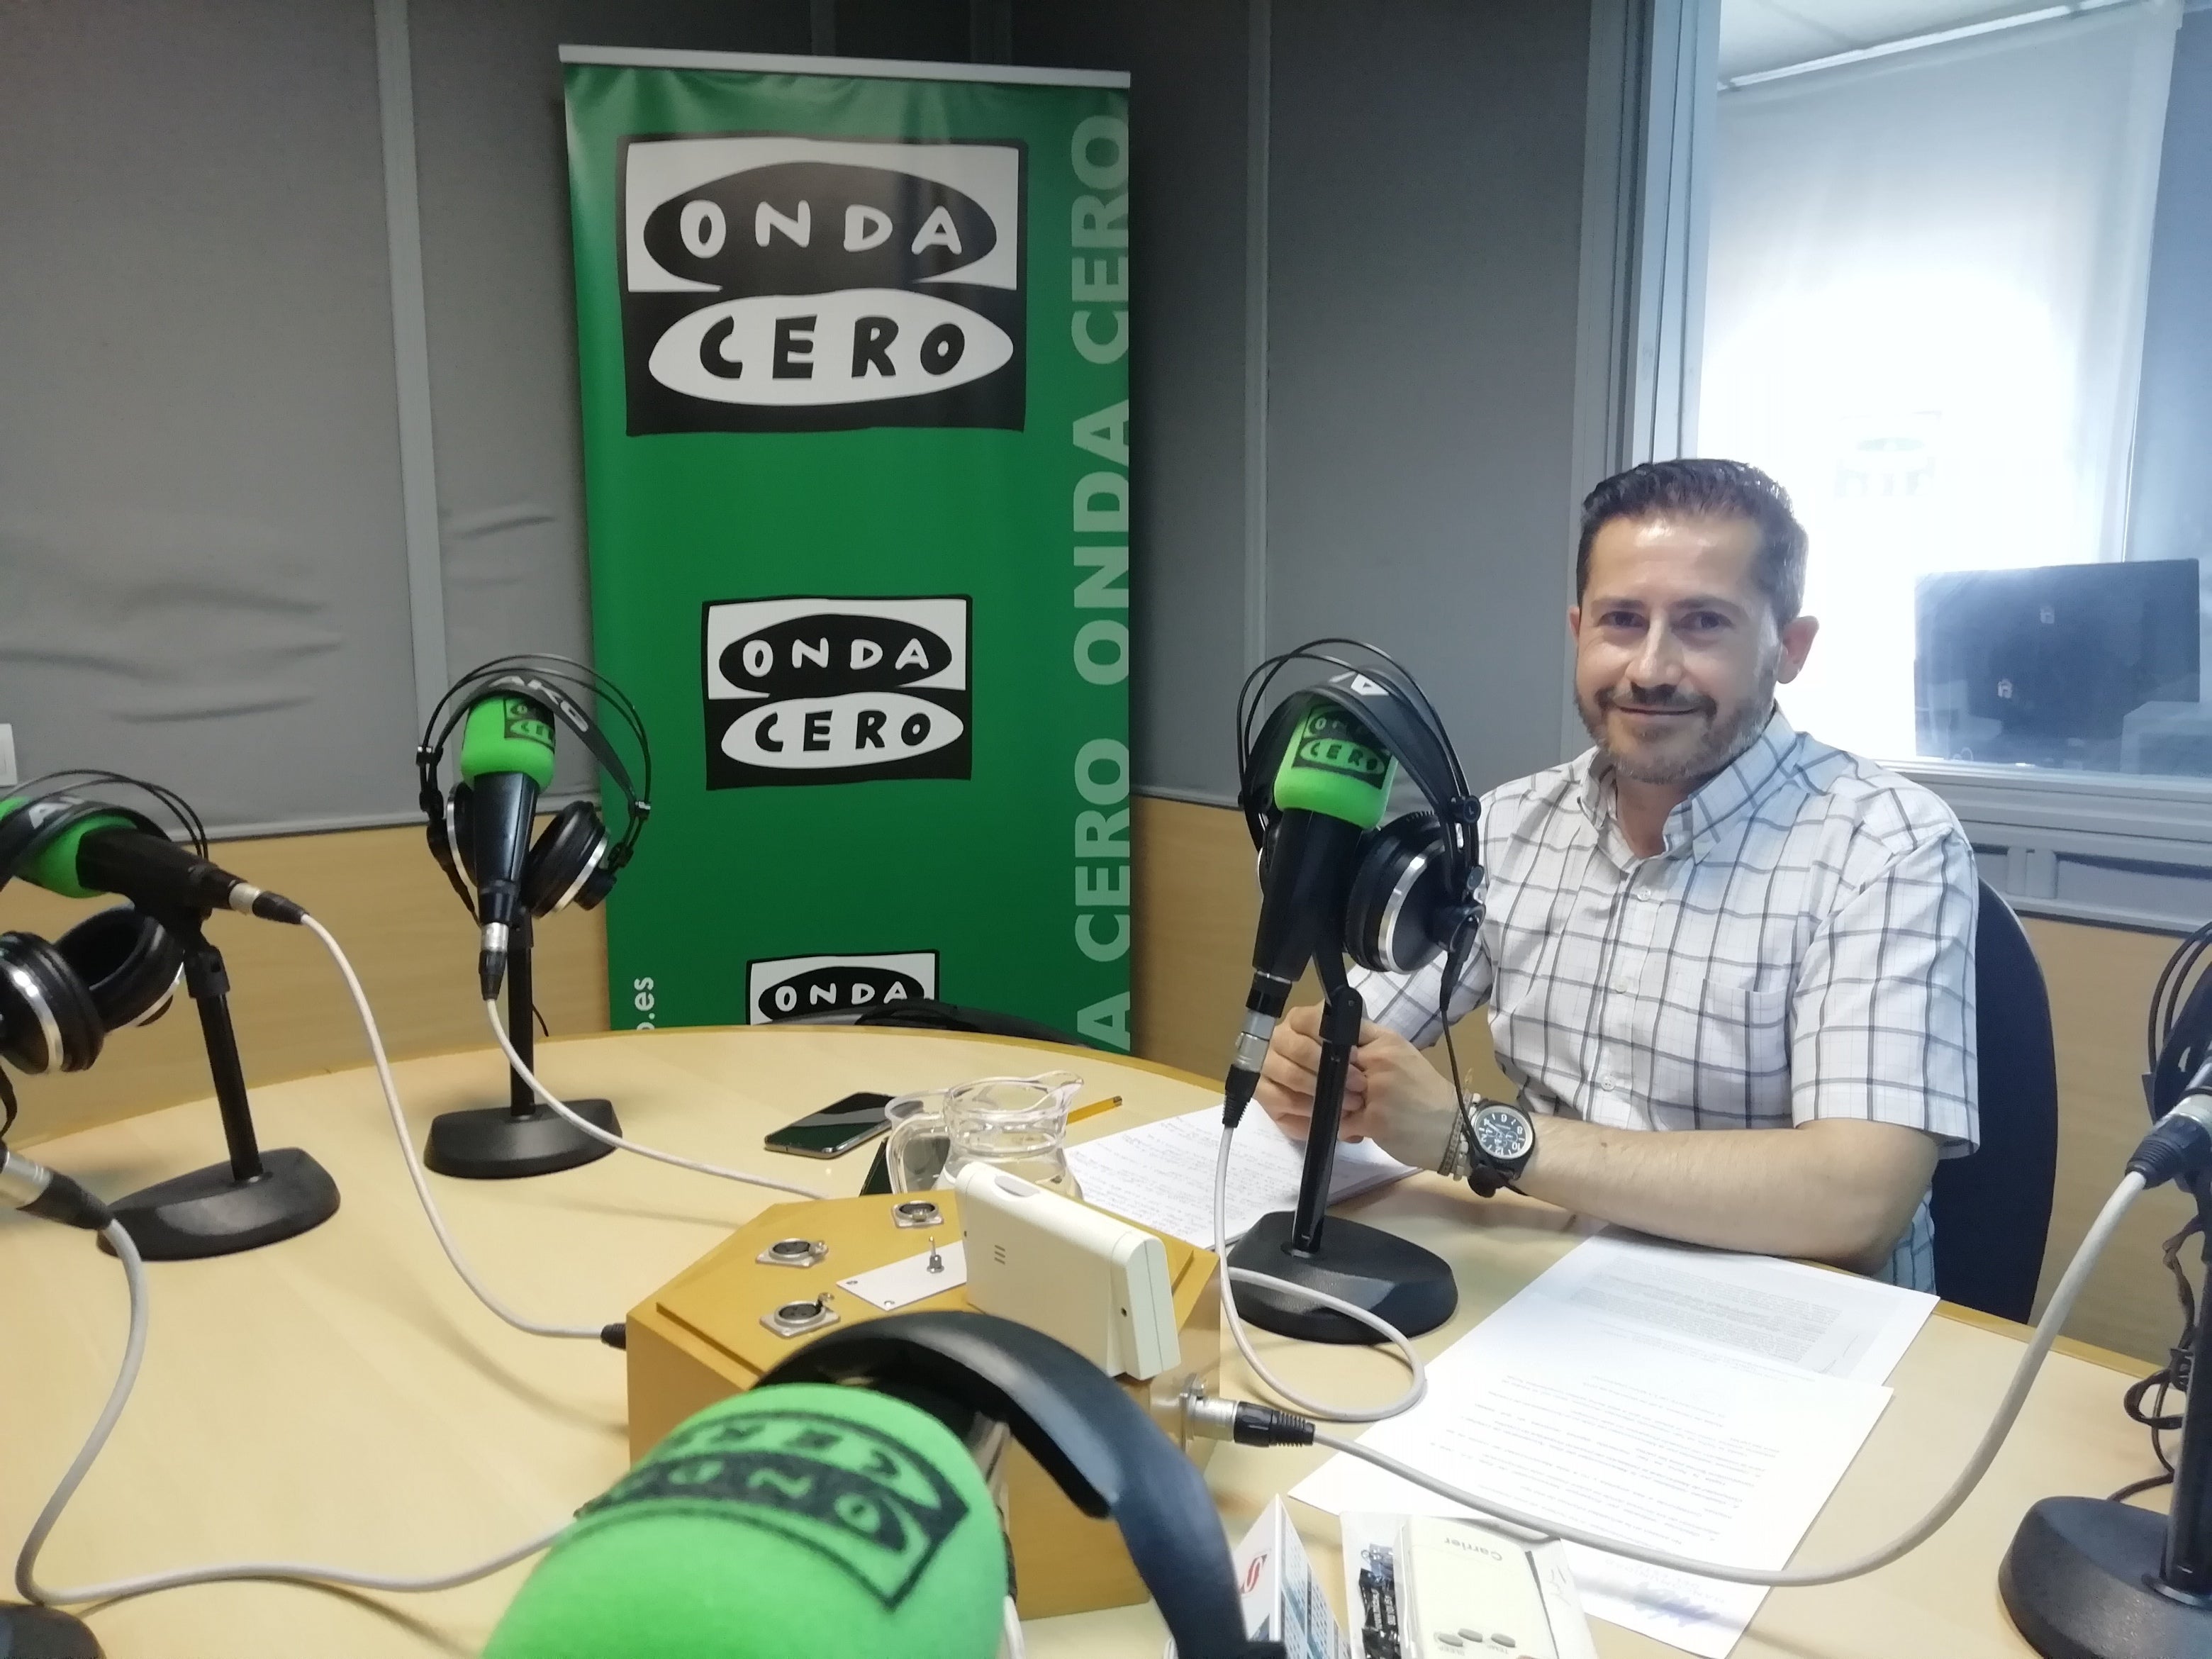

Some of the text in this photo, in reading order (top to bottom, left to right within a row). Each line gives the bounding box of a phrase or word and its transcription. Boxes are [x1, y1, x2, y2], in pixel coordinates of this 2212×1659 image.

[679, 199, 963, 258] ONDA
[1071, 115, 1129, 364] CERO
[699, 314, 966, 380] CERO
[1072, 398, 1129, 686] ONDA
[742, 637, 929, 676] ONDA
[754, 709, 932, 752] CERO
[1074, 738, 1130, 962] CERO
[774, 981, 908, 1012] ONDA
[1443, 1536, 1503, 1562] Carrier
